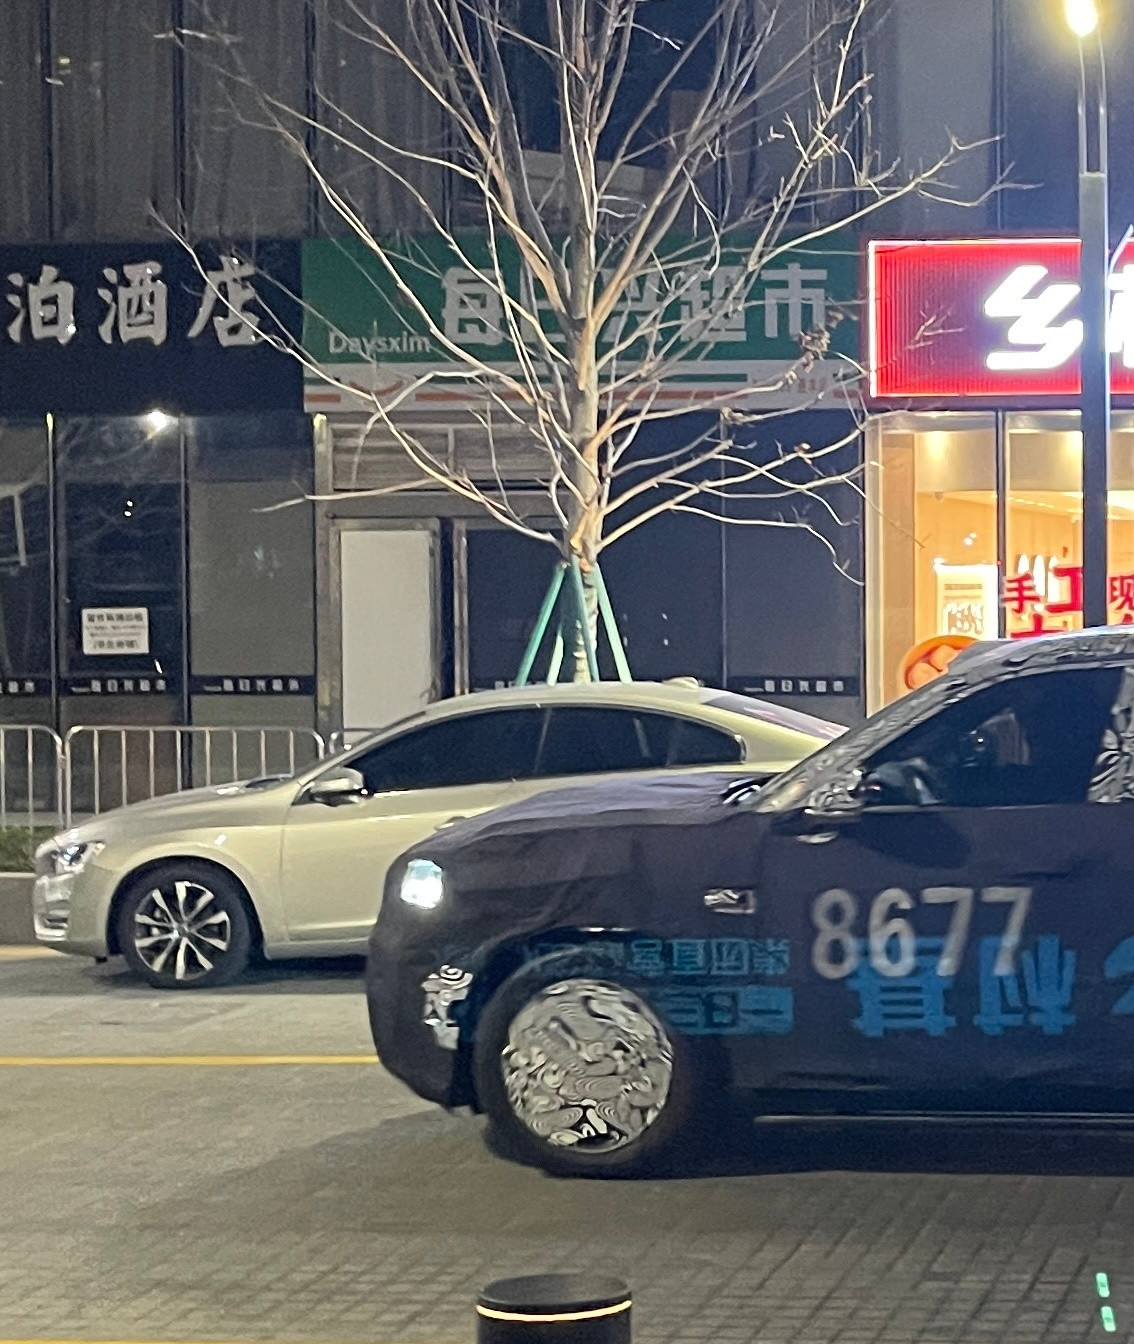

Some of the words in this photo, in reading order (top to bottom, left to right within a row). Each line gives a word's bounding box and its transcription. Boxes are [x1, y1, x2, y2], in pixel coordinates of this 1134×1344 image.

[6, 256, 264, 346] 泊酒店
[811, 886, 1033, 979] 8677
